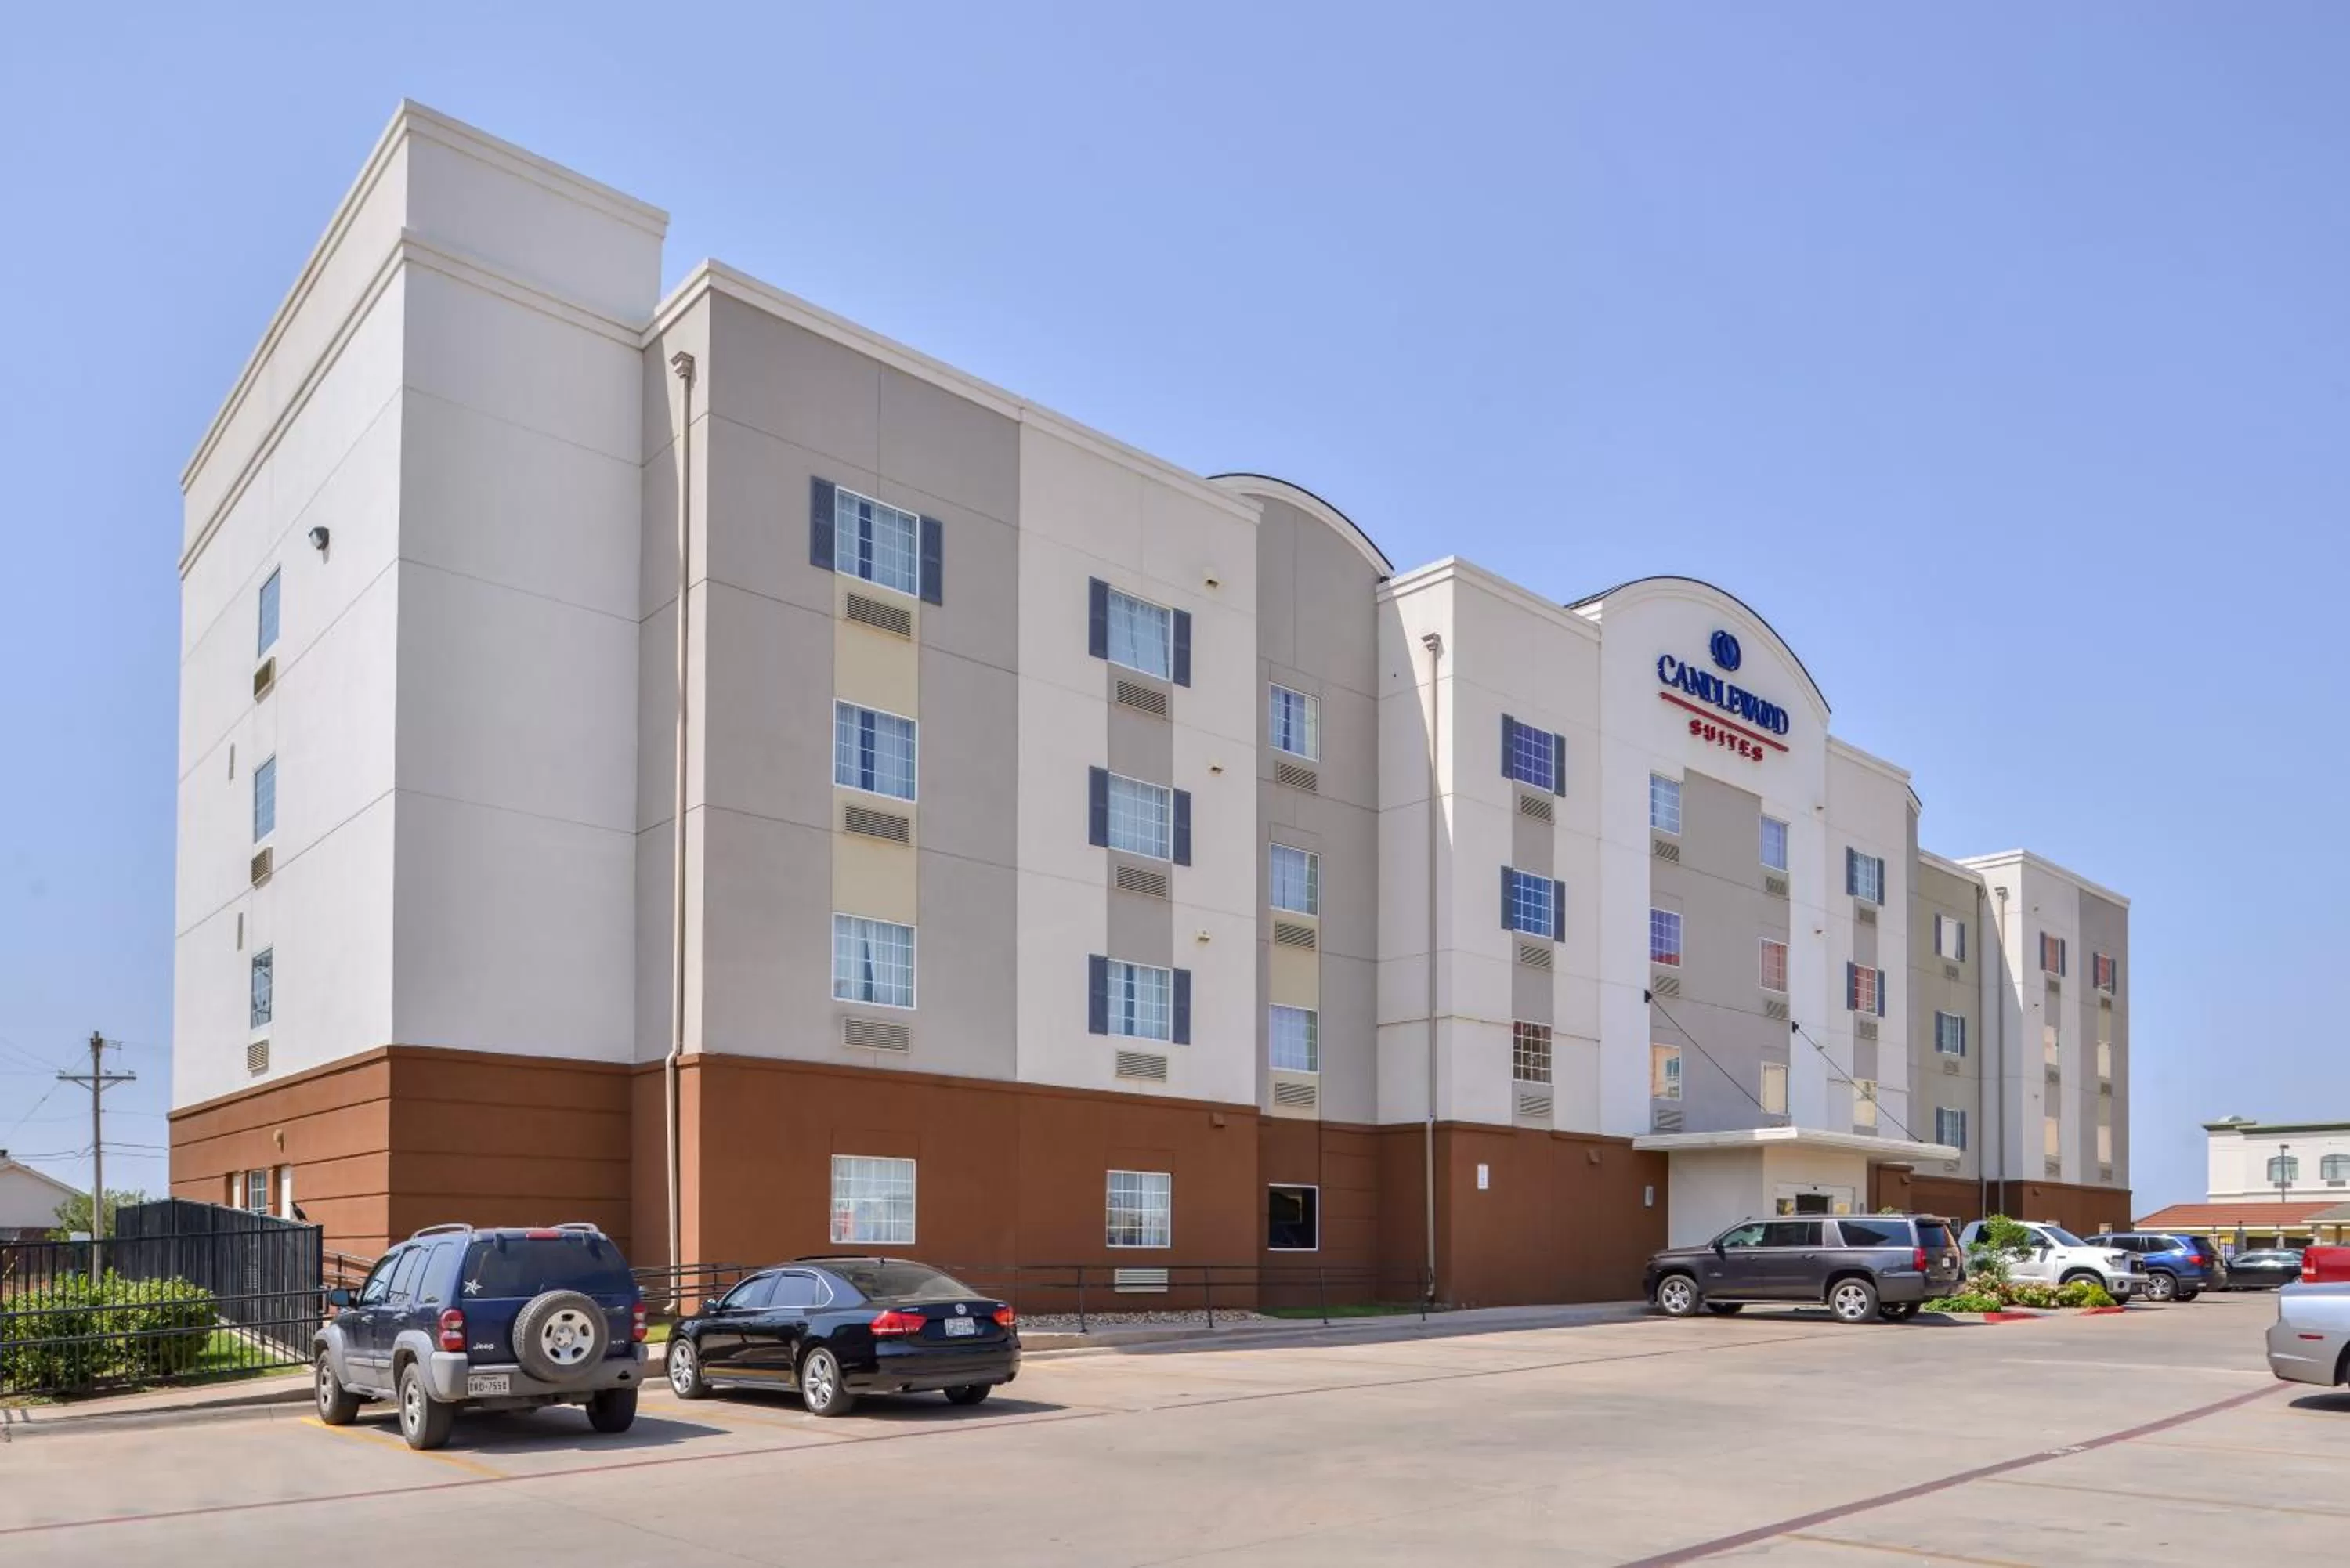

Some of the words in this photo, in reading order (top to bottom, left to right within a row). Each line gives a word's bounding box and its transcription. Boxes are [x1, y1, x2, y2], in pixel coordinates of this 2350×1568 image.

[1658, 654, 1789, 735] CANDLEWOOD
[1689, 719, 1763, 762] SUITES
[472, 1342, 494, 1351] Jeep
